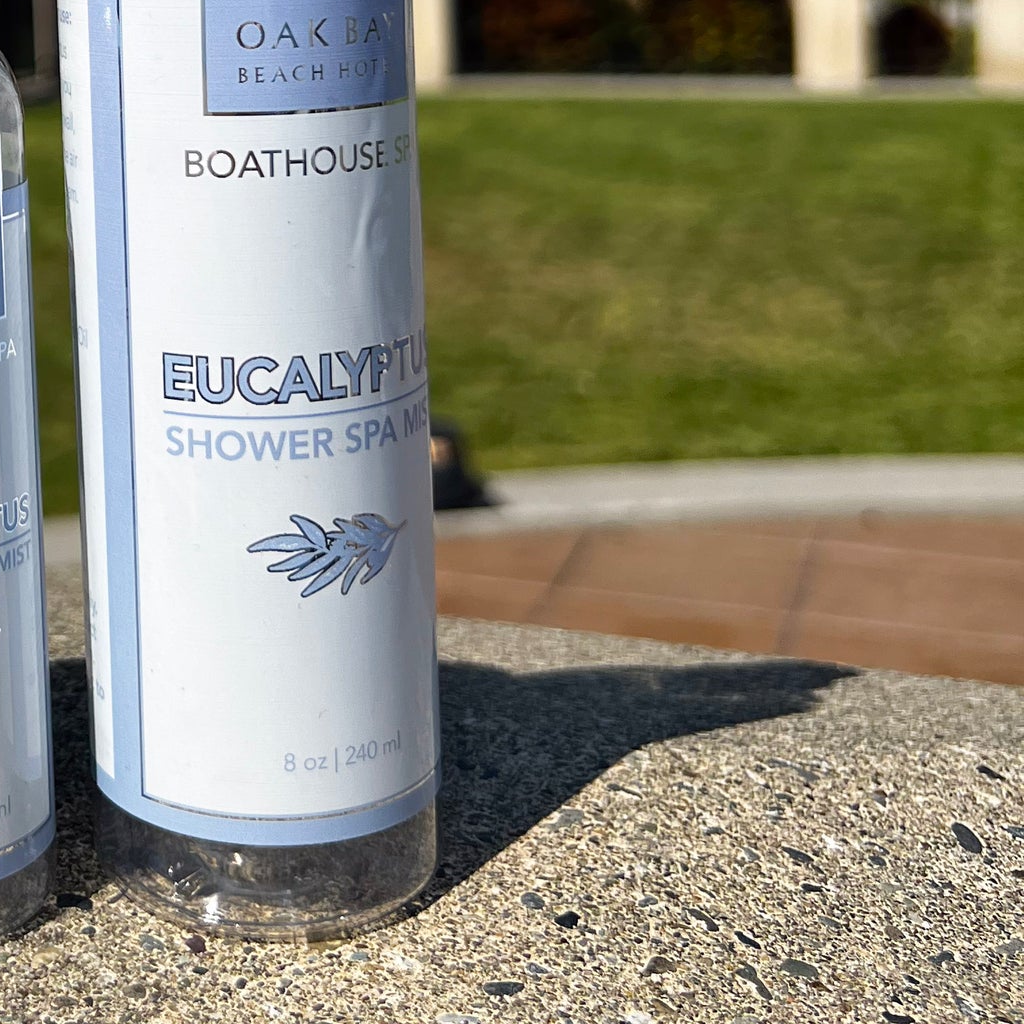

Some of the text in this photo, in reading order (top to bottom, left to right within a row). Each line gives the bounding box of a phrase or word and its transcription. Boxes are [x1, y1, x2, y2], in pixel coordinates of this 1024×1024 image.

[236, 11, 395, 51] OAK BAY
[238, 63, 325, 84] BEACH
[185, 133, 410, 179] BOATHOUSE SP
[161, 329, 426, 405] EUCALYPTU
[165, 396, 428, 462] SHOWER SPA MIS
[284, 752, 296, 772] 8
[303, 756, 329, 771] oz
[345, 740, 378, 766] 240
[382, 729, 401, 756] ml
